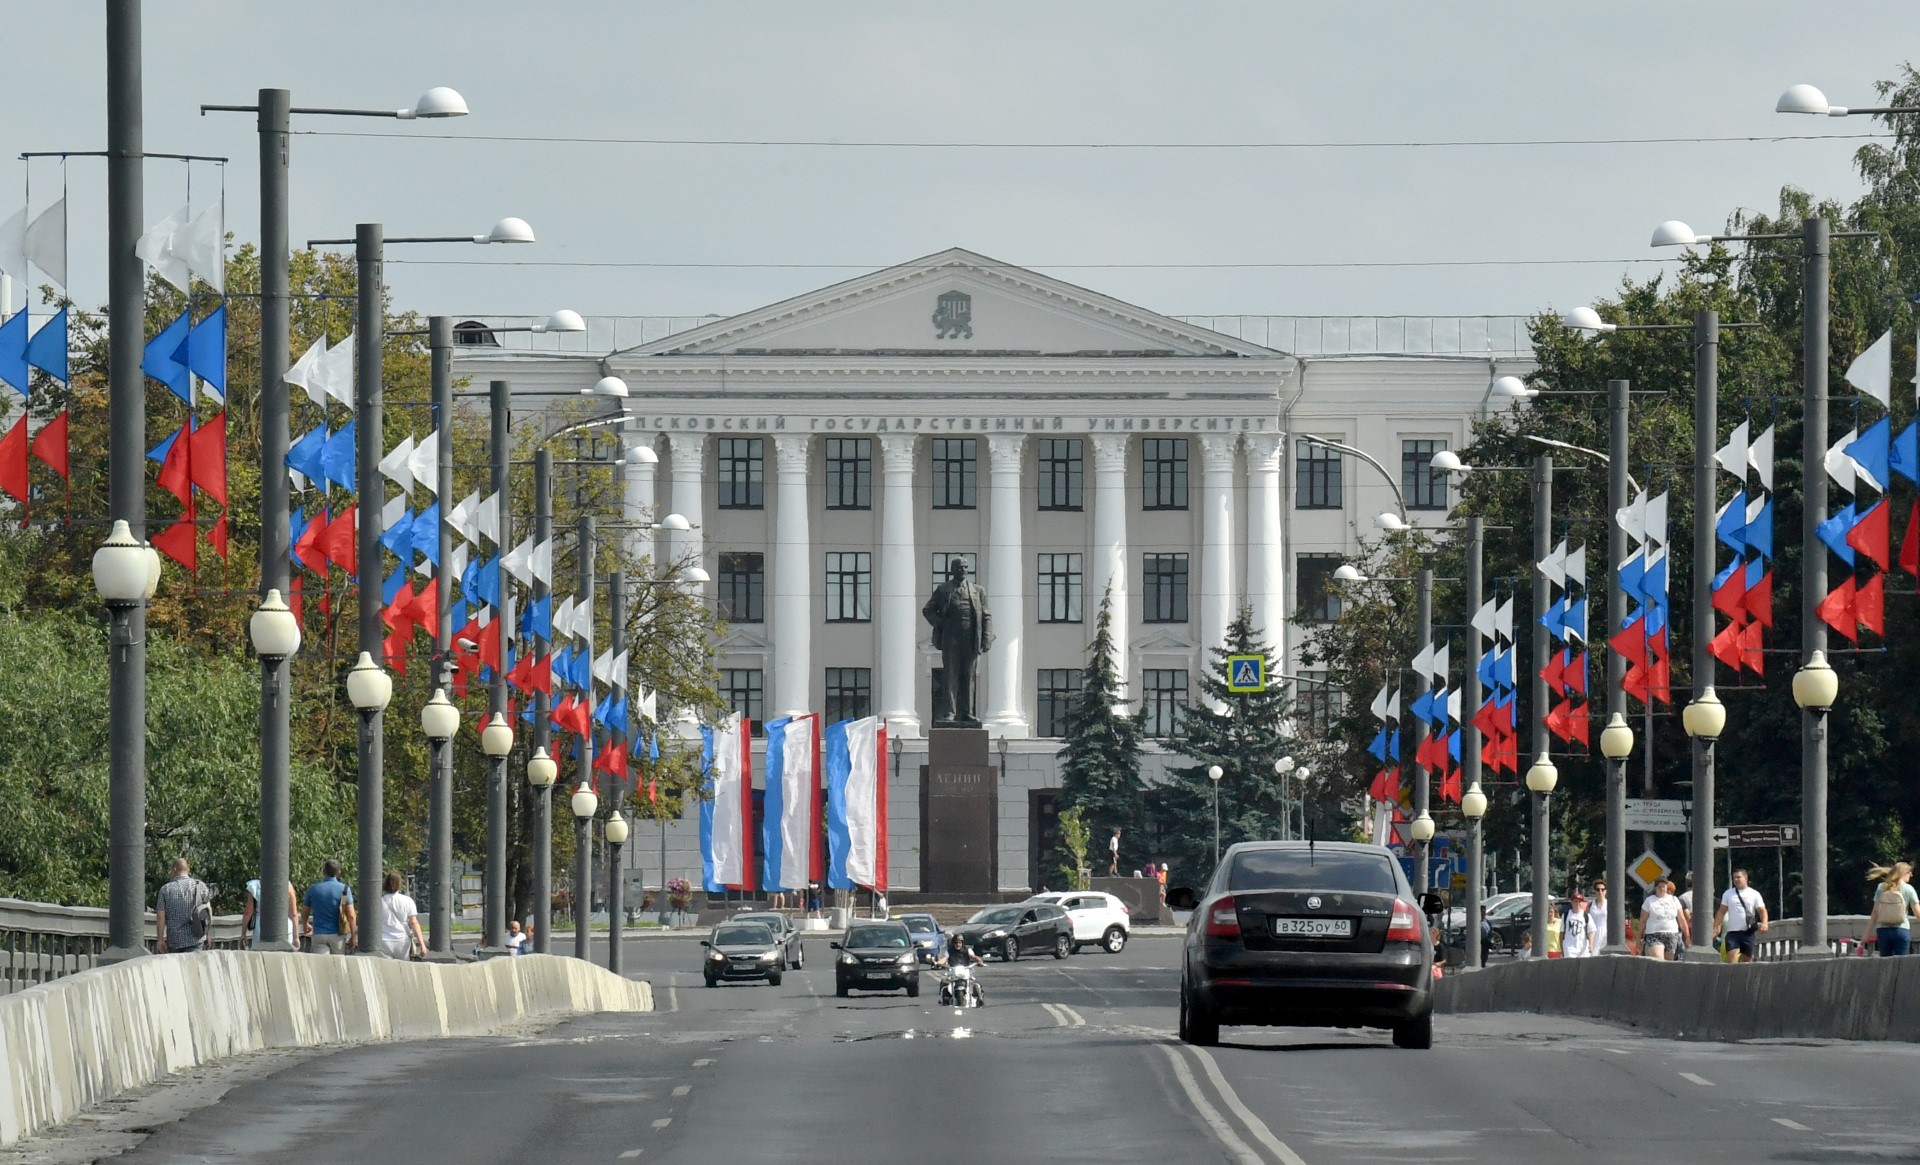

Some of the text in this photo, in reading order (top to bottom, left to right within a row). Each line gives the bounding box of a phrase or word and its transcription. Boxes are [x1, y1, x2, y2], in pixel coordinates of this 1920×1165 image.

[636, 415, 1266, 431] ПСКОВСКИЙ ГОСУДАРСТВЕННЫЙ УНИВЕРСИТЕТ
[1282, 920, 1347, 933] В325ОУ 60
